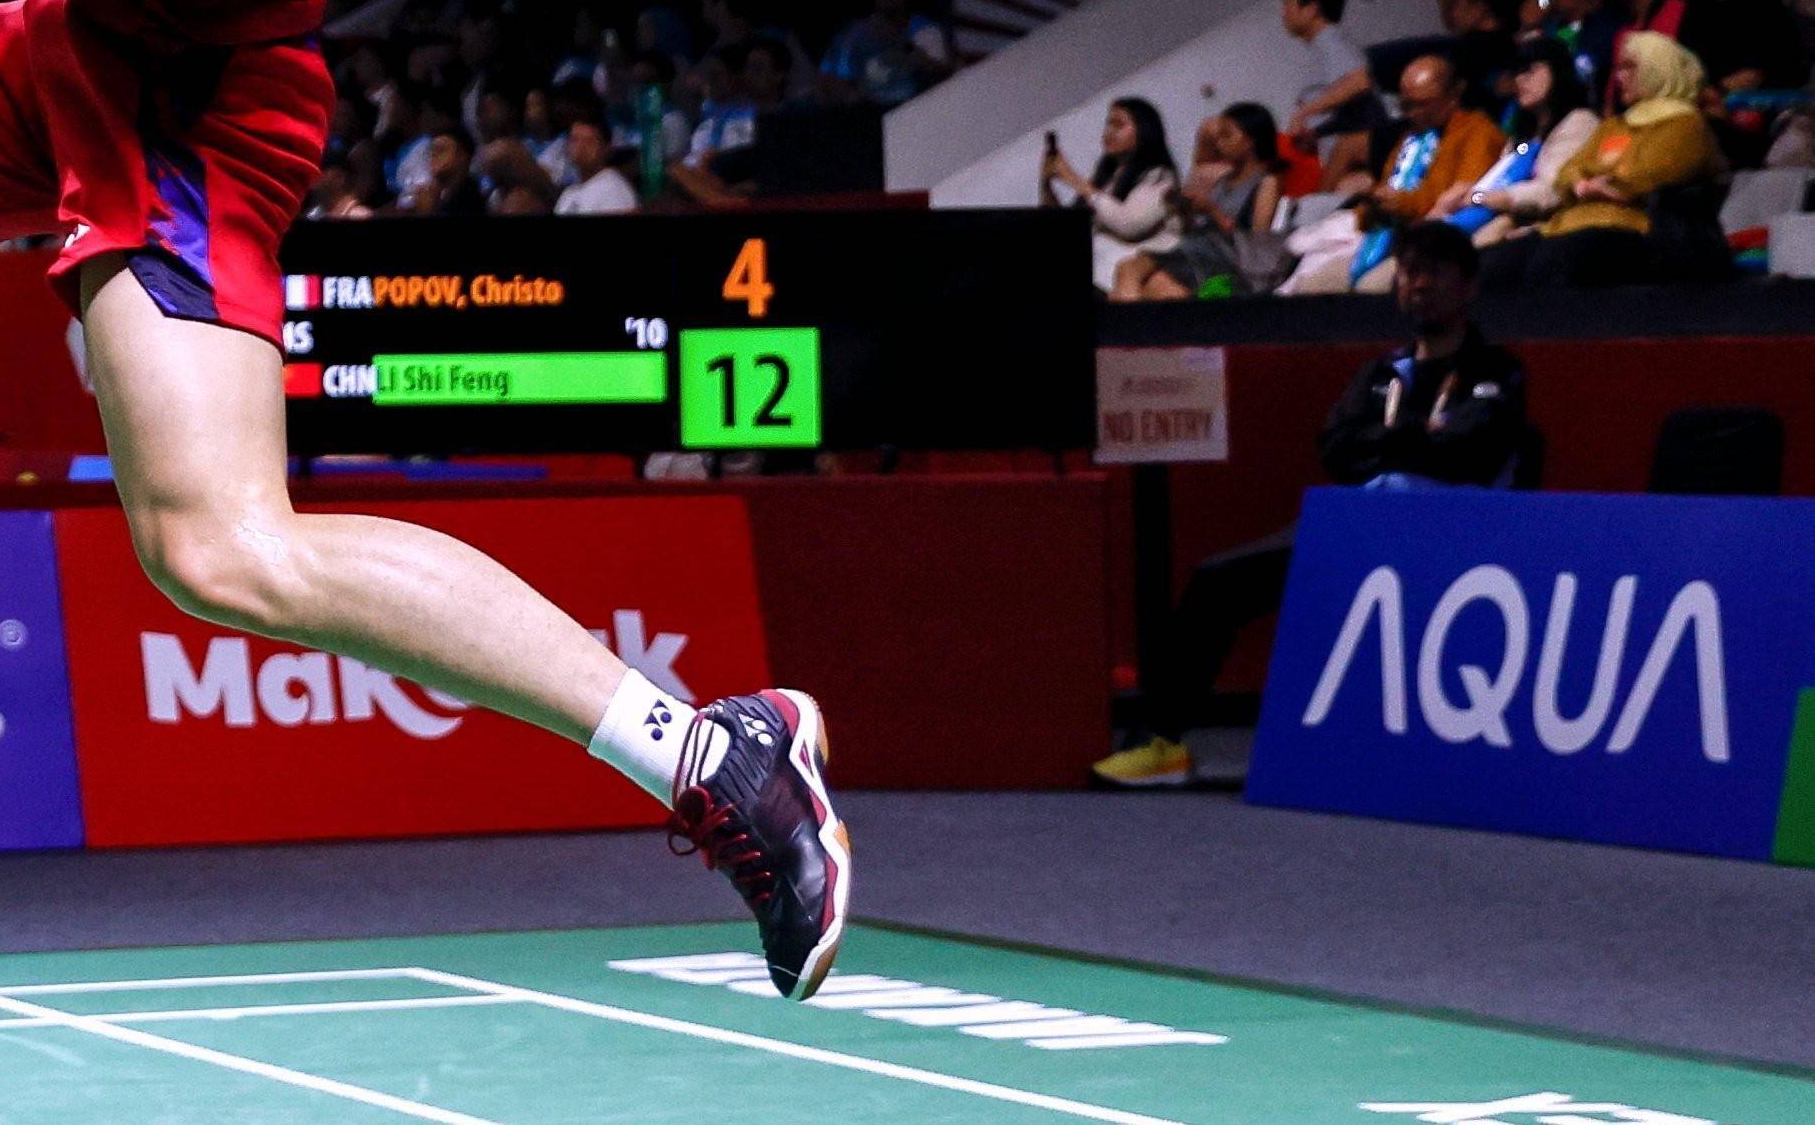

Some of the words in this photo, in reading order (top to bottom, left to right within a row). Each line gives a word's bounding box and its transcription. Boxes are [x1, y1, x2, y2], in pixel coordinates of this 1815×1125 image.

[322, 275, 374, 309] FRA
[374, 275, 468, 311] POPOV,
[470, 274, 565, 306] Christo
[722, 237, 775, 318] 4
[322, 364, 376, 398] CHN
[403, 364, 443, 393] Shi
[449, 364, 509, 396] Feng
[705, 353, 793, 428] 12
[1102, 408, 1134, 444] NO
[1140, 406, 1214, 443] ENTRY
[1301, 564, 1731, 764] AQUA
